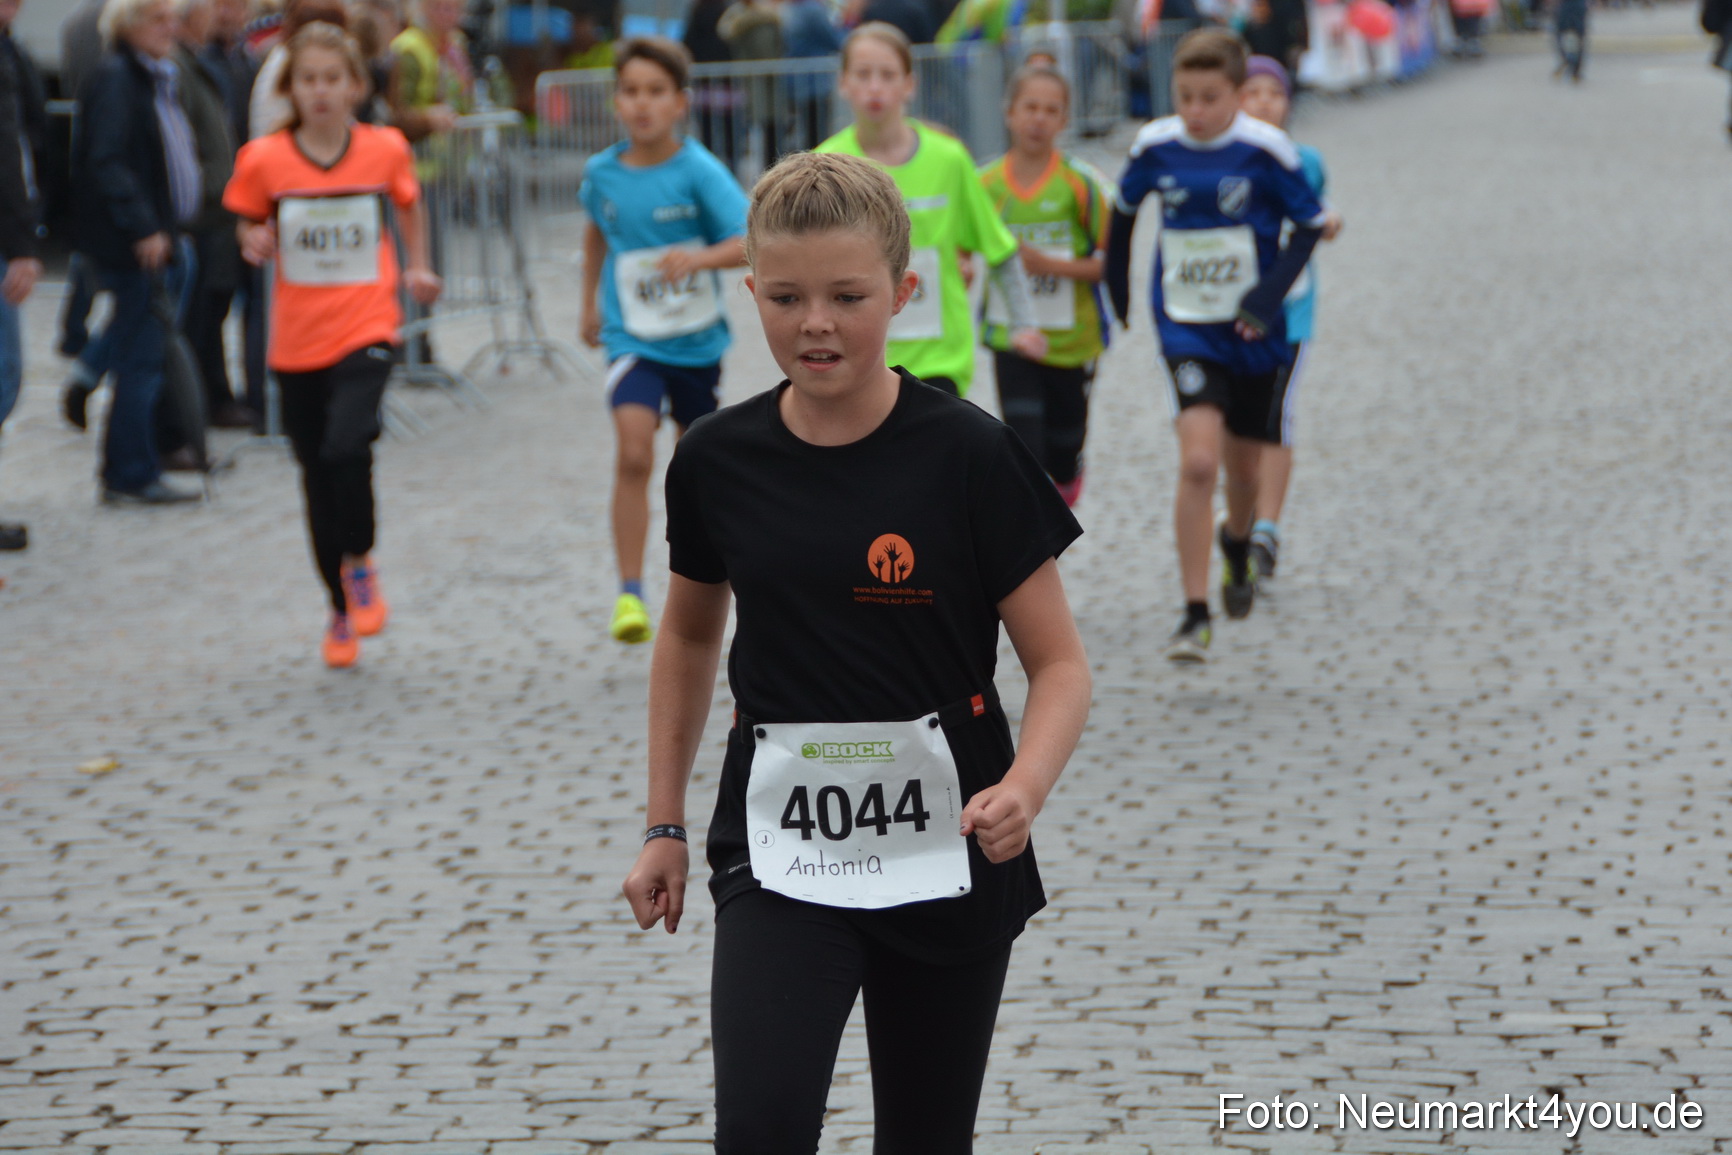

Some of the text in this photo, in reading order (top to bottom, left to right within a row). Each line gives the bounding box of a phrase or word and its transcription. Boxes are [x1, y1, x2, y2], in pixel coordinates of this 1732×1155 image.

[294, 223, 366, 253] 4013
[1177, 254, 1241, 285] 4022
[822, 741, 894, 758] BOCK
[780, 778, 931, 841] 4044
[761, 834, 769, 844] J
[785, 849, 883, 877] Antonia
